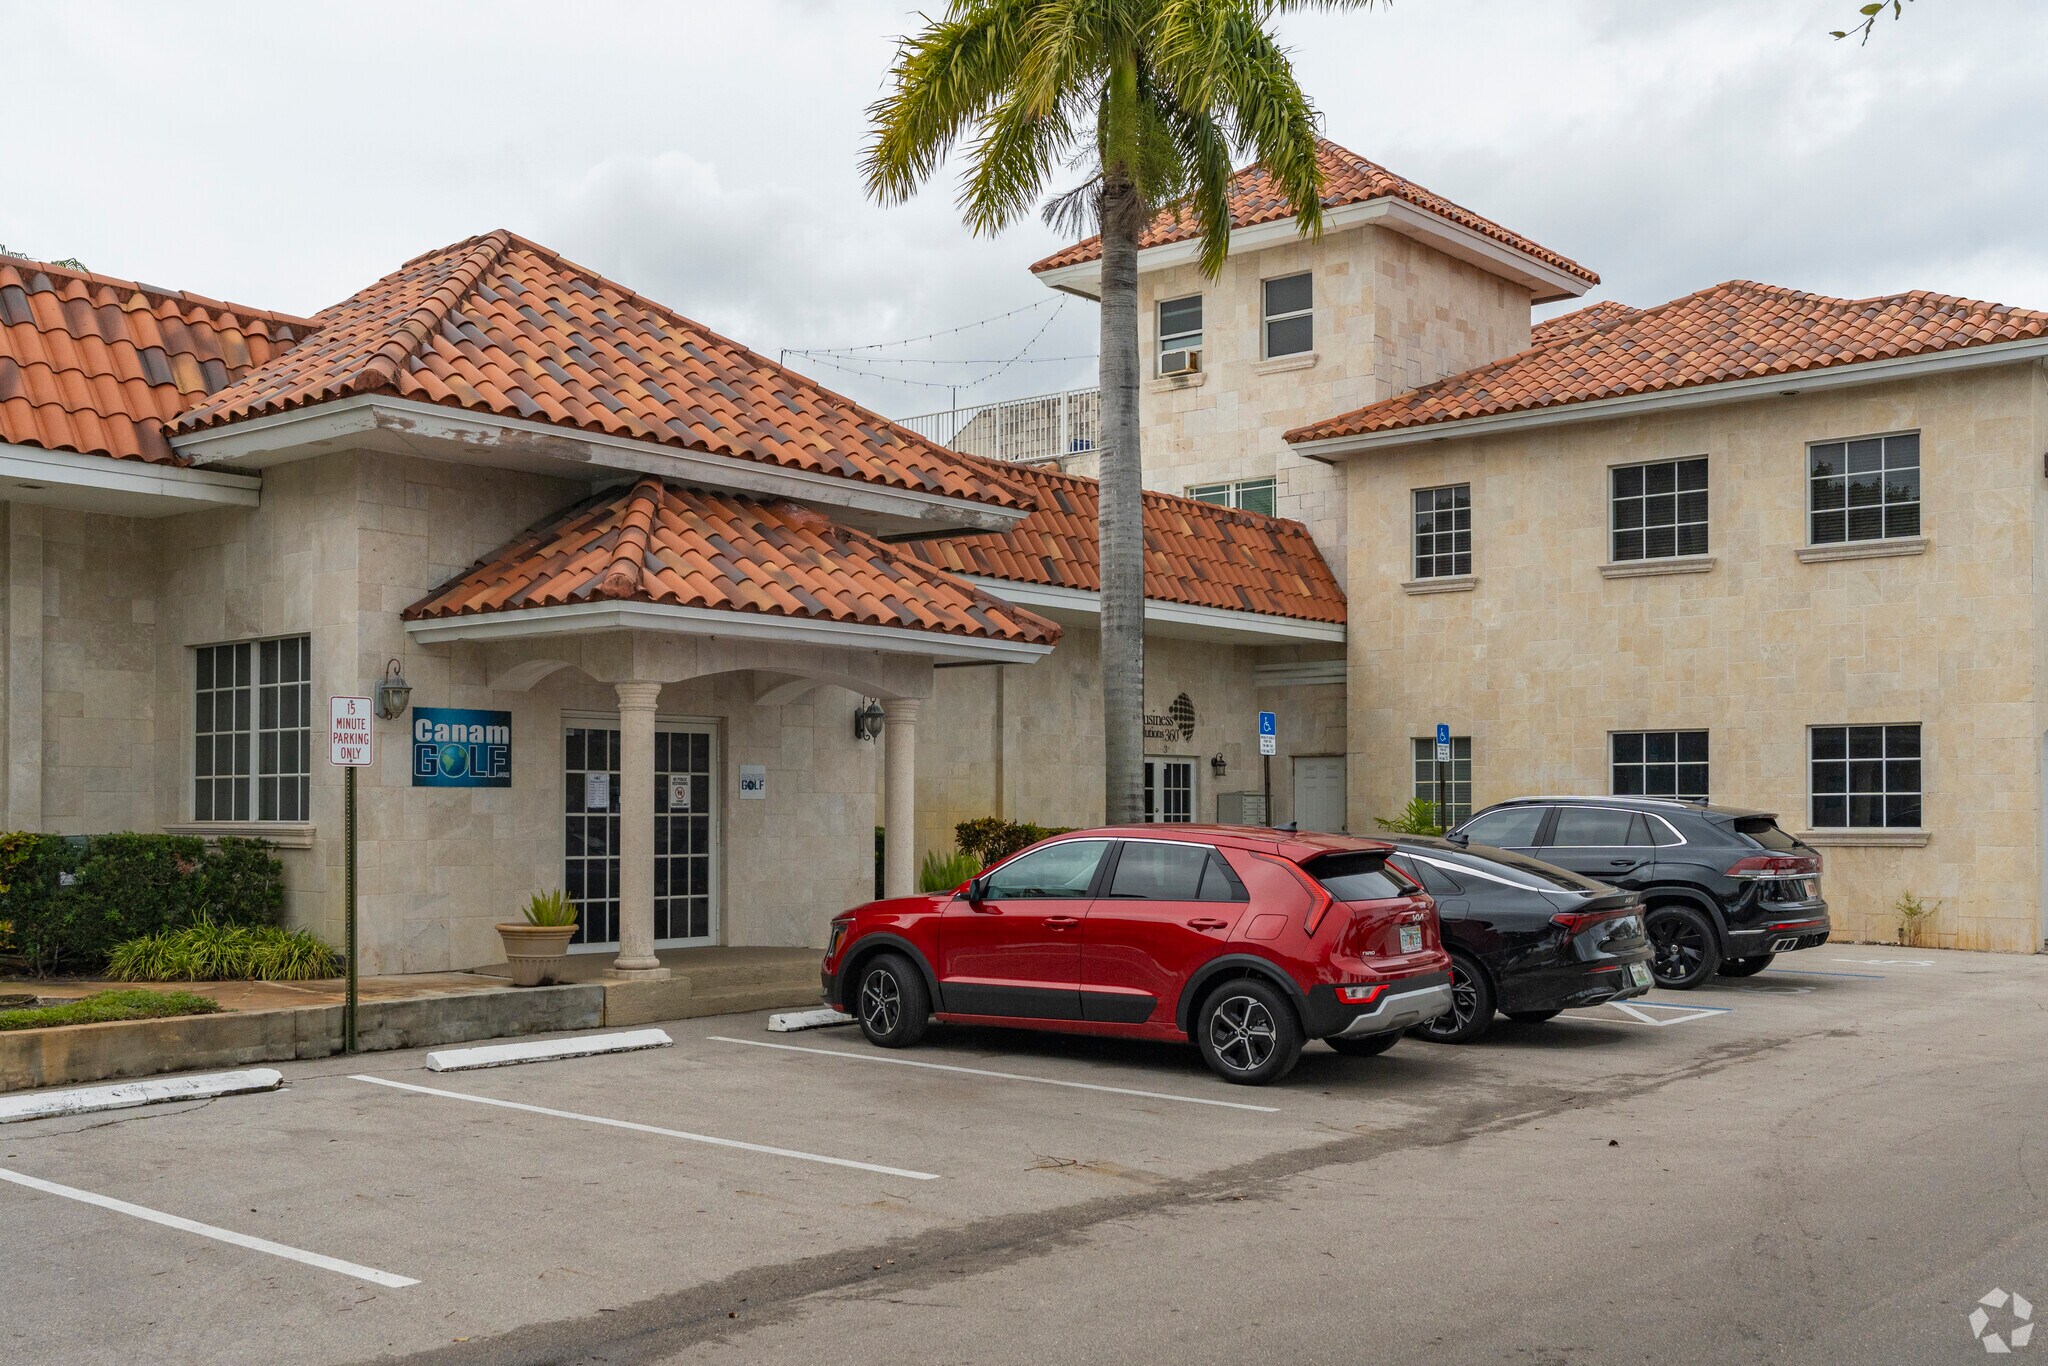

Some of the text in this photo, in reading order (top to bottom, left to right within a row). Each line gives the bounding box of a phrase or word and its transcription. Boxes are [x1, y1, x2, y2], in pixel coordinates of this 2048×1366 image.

[347, 703, 356, 715] 15
[336, 717, 366, 730] MINUTE
[1143, 709, 1174, 726] usiness
[415, 718, 510, 745] Canam
[333, 732, 369, 745] PARKING
[340, 747, 361, 760] ONLY
[414, 743, 507, 778] GOLF
[741, 780, 765, 791] GOLF
